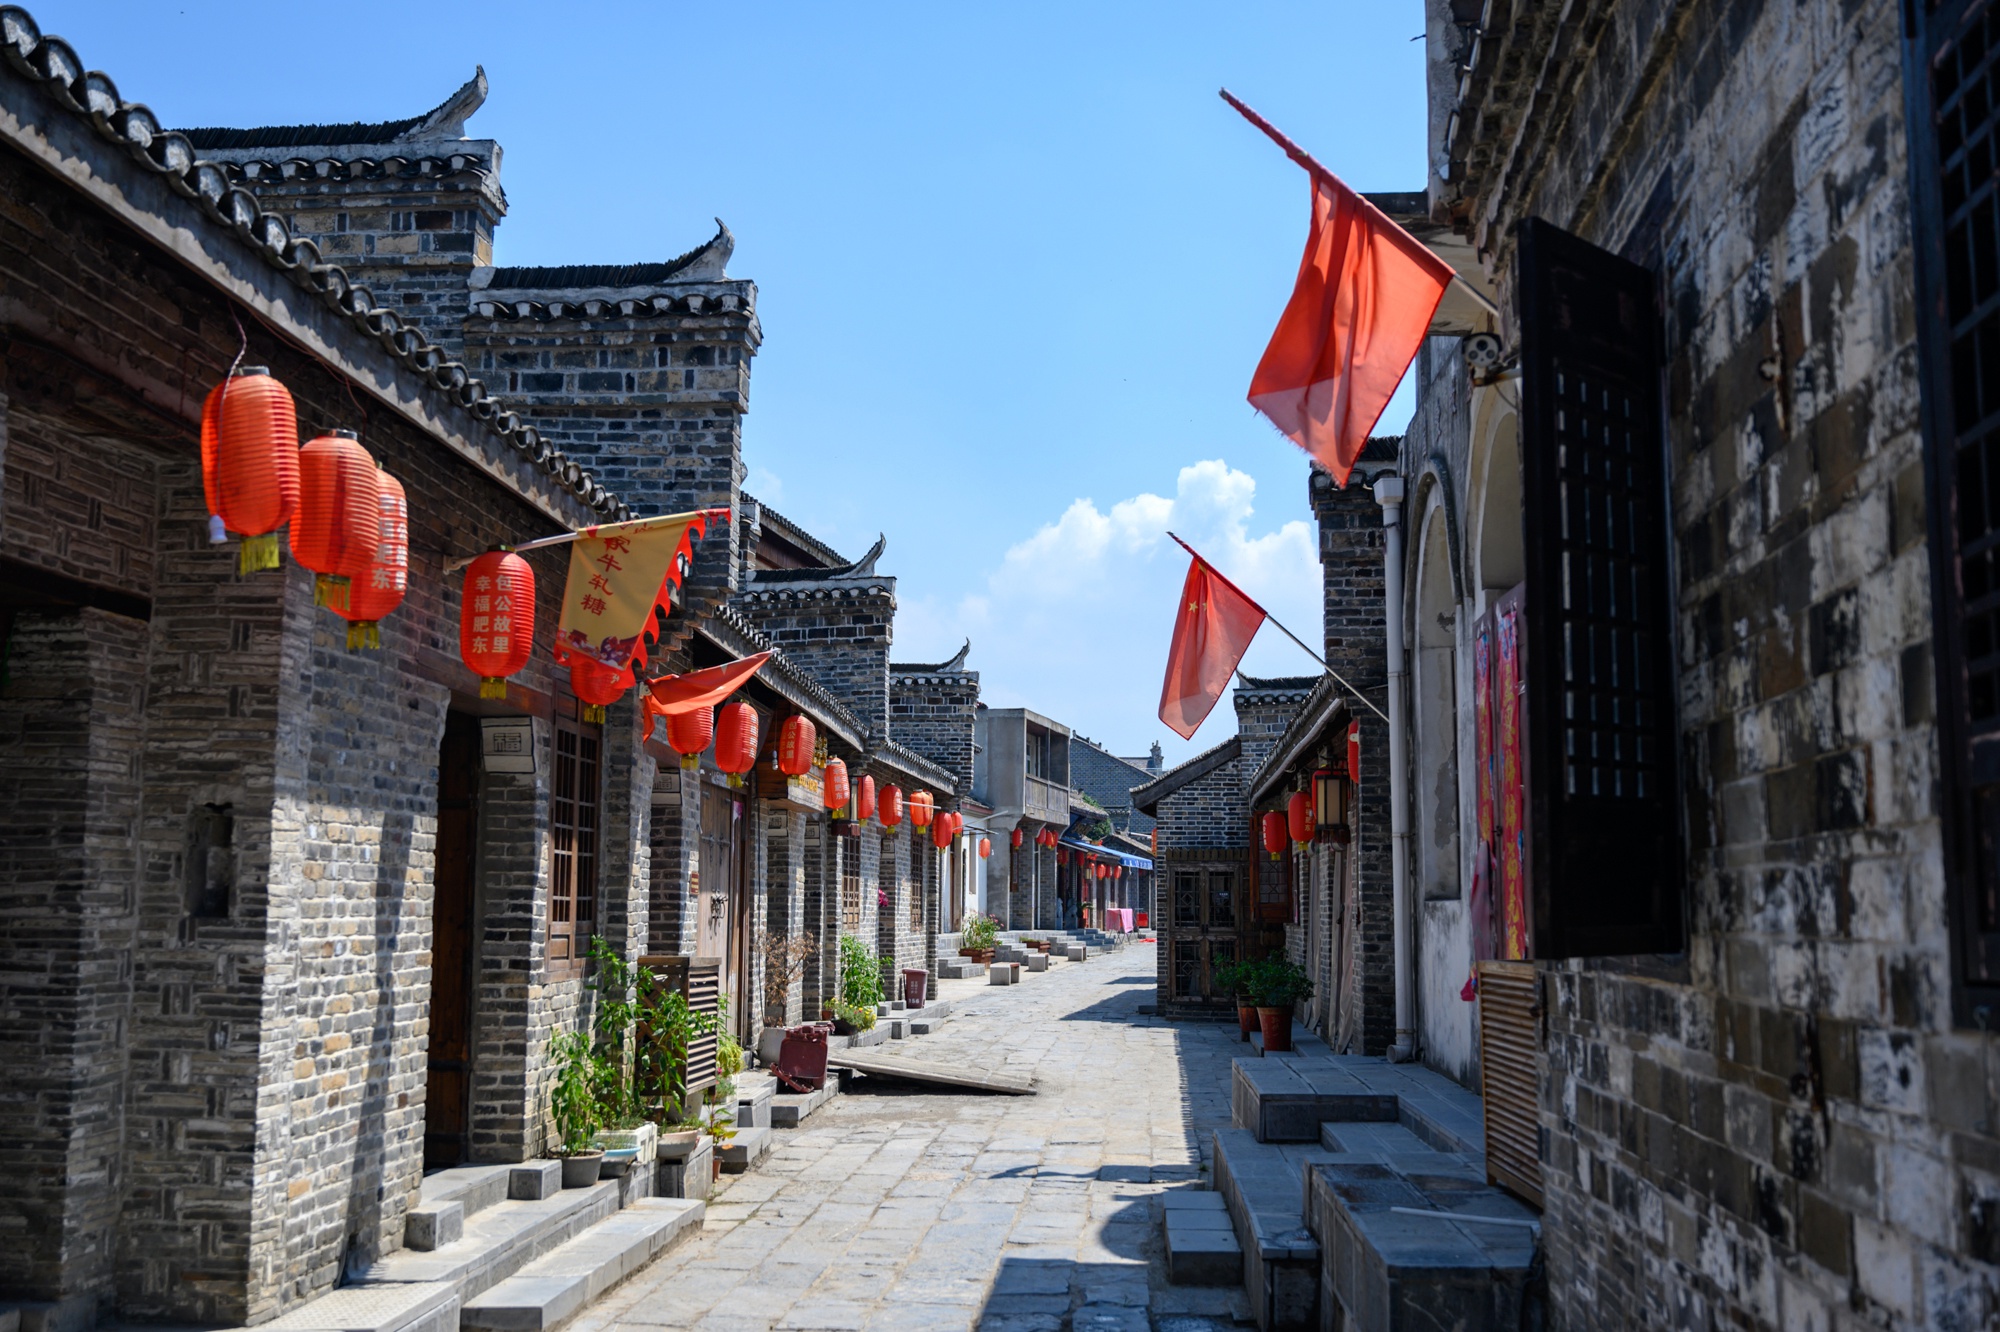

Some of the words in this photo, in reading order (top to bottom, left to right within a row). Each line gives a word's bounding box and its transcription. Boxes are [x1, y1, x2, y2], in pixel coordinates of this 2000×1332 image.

[580, 522, 634, 616] 家牛轧糖
[472, 575, 491, 654] 幸福肥东
[491, 574, 513, 653] 包公故里
